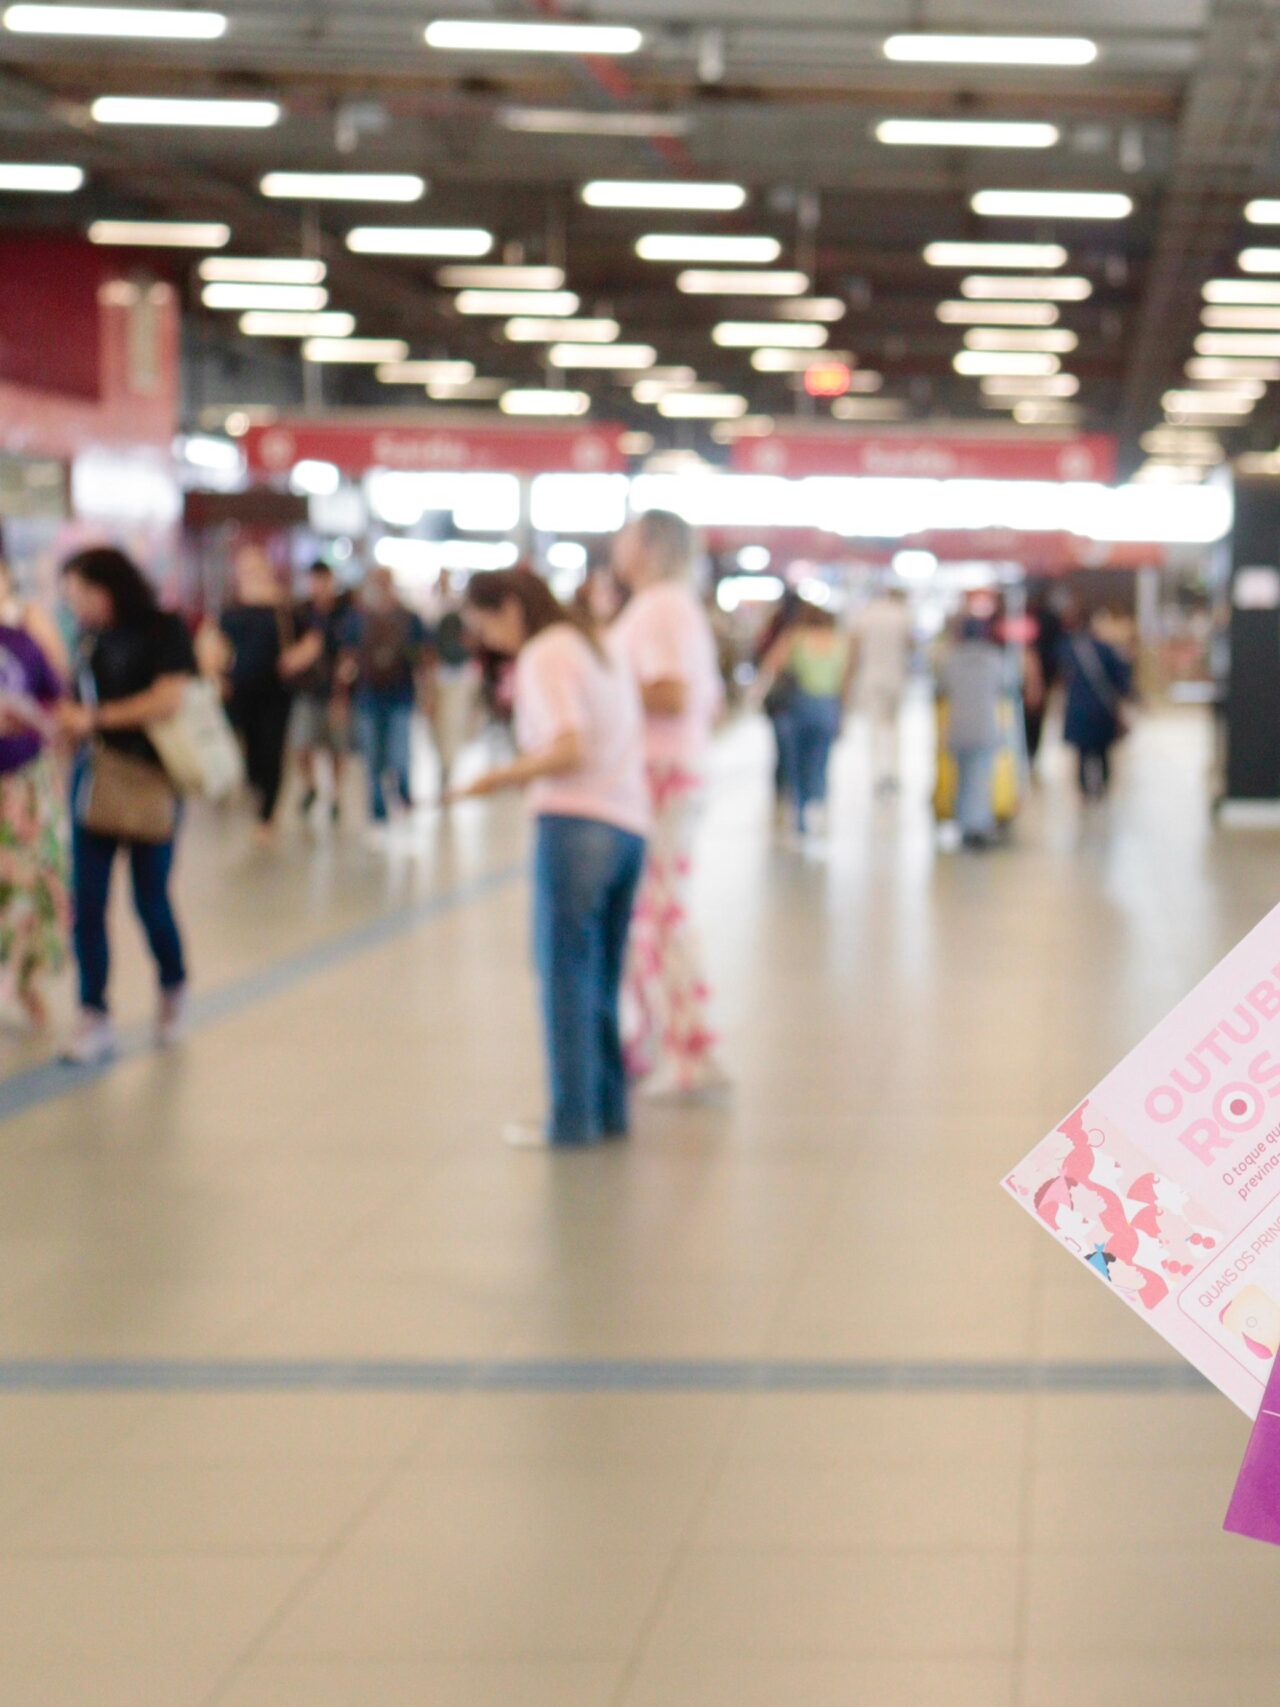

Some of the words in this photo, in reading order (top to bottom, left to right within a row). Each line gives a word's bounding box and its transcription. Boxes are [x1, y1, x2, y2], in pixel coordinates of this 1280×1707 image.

[1222, 1172, 1234, 1186] O
[1232, 1142, 1267, 1176] toque
[1198, 1268, 1239, 1308] QUAIS
[1234, 1250, 1256, 1272] OS
